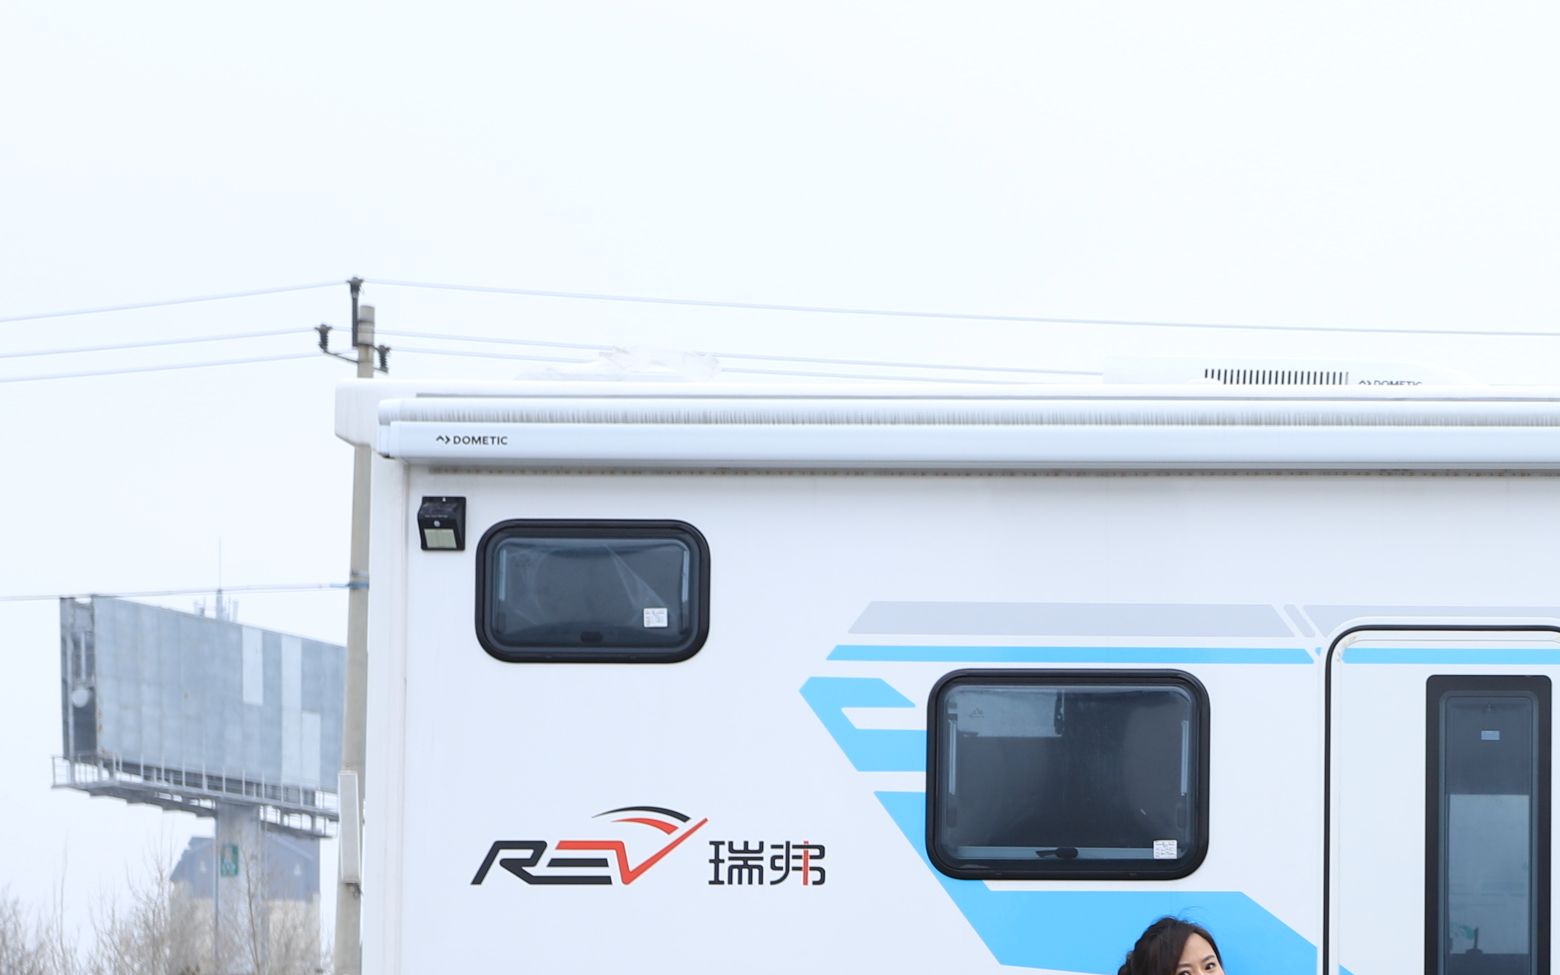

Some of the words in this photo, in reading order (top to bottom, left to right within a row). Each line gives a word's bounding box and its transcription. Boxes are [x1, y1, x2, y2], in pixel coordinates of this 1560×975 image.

[453, 435, 508, 446] DOMETIC
[470, 817, 709, 886] REV
[708, 840, 826, 886] 瑞弗
